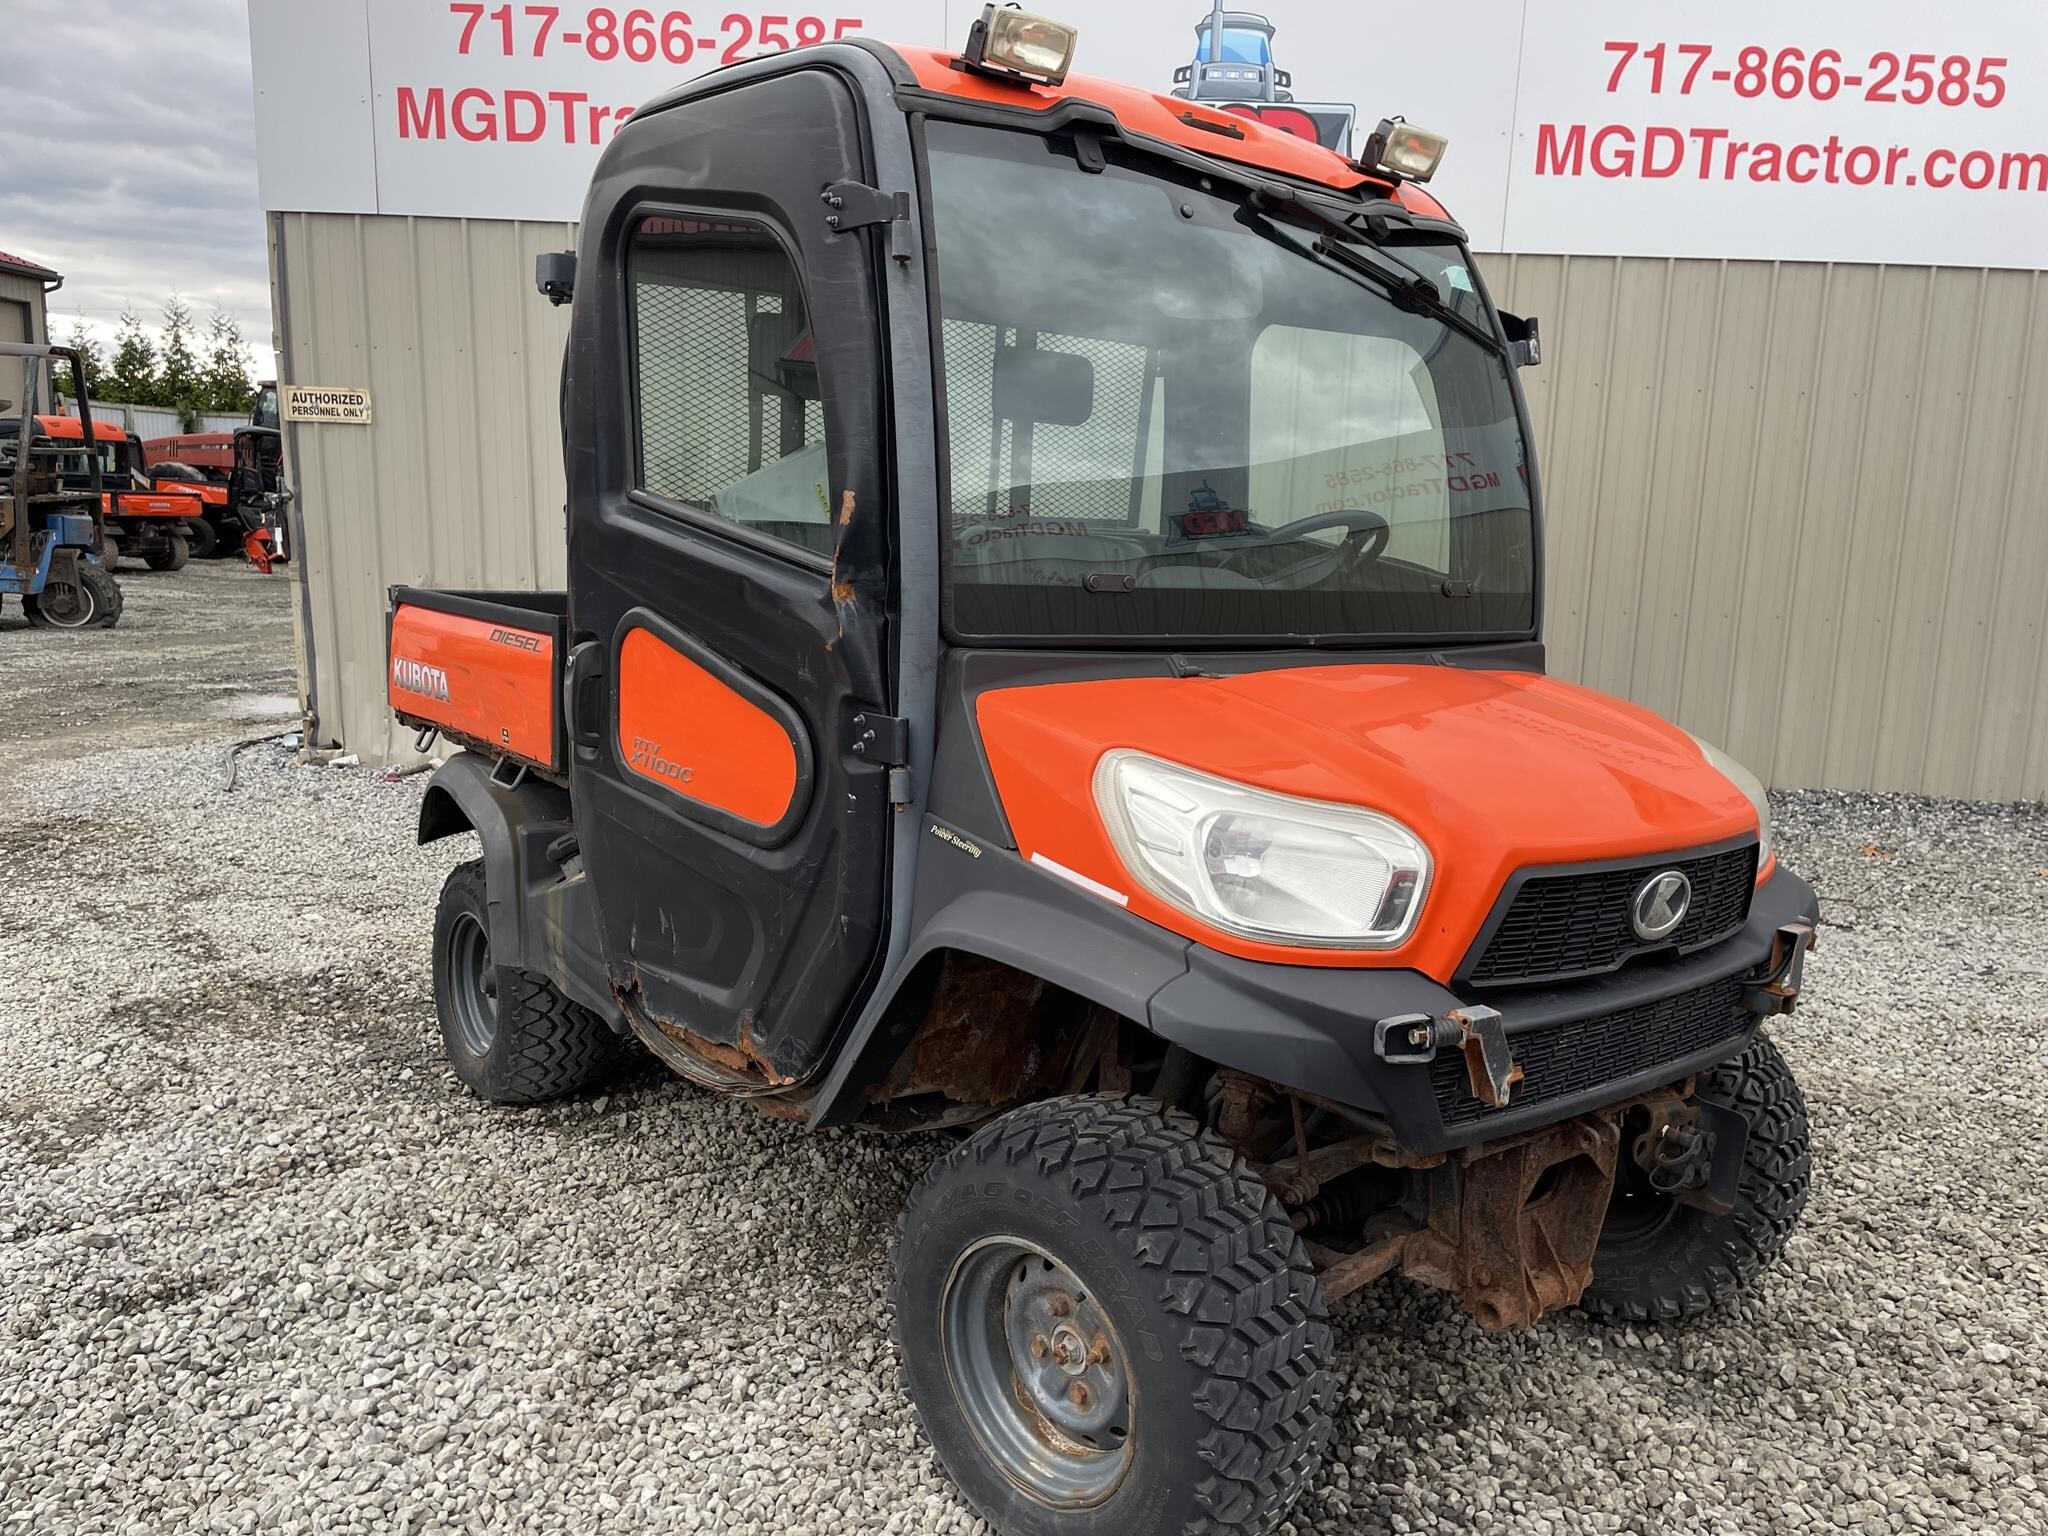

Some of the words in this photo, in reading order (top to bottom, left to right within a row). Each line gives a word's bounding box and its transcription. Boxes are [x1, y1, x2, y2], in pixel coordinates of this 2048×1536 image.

[1603, 41, 2009, 108] 717-866-2585
[1534, 123, 2048, 192] MGDTractor.com
[291, 392, 364, 405] AUTHORIZED
[292, 406, 341, 416] PERSONNEL
[343, 407, 364, 417] ONLY
[489, 628, 542, 653] DIESEL
[394, 657, 451, 703] KUBOTA
[633, 736, 661, 755] RTV
[930, 824, 953, 841] Power
[951, 835, 982, 858] Steering
